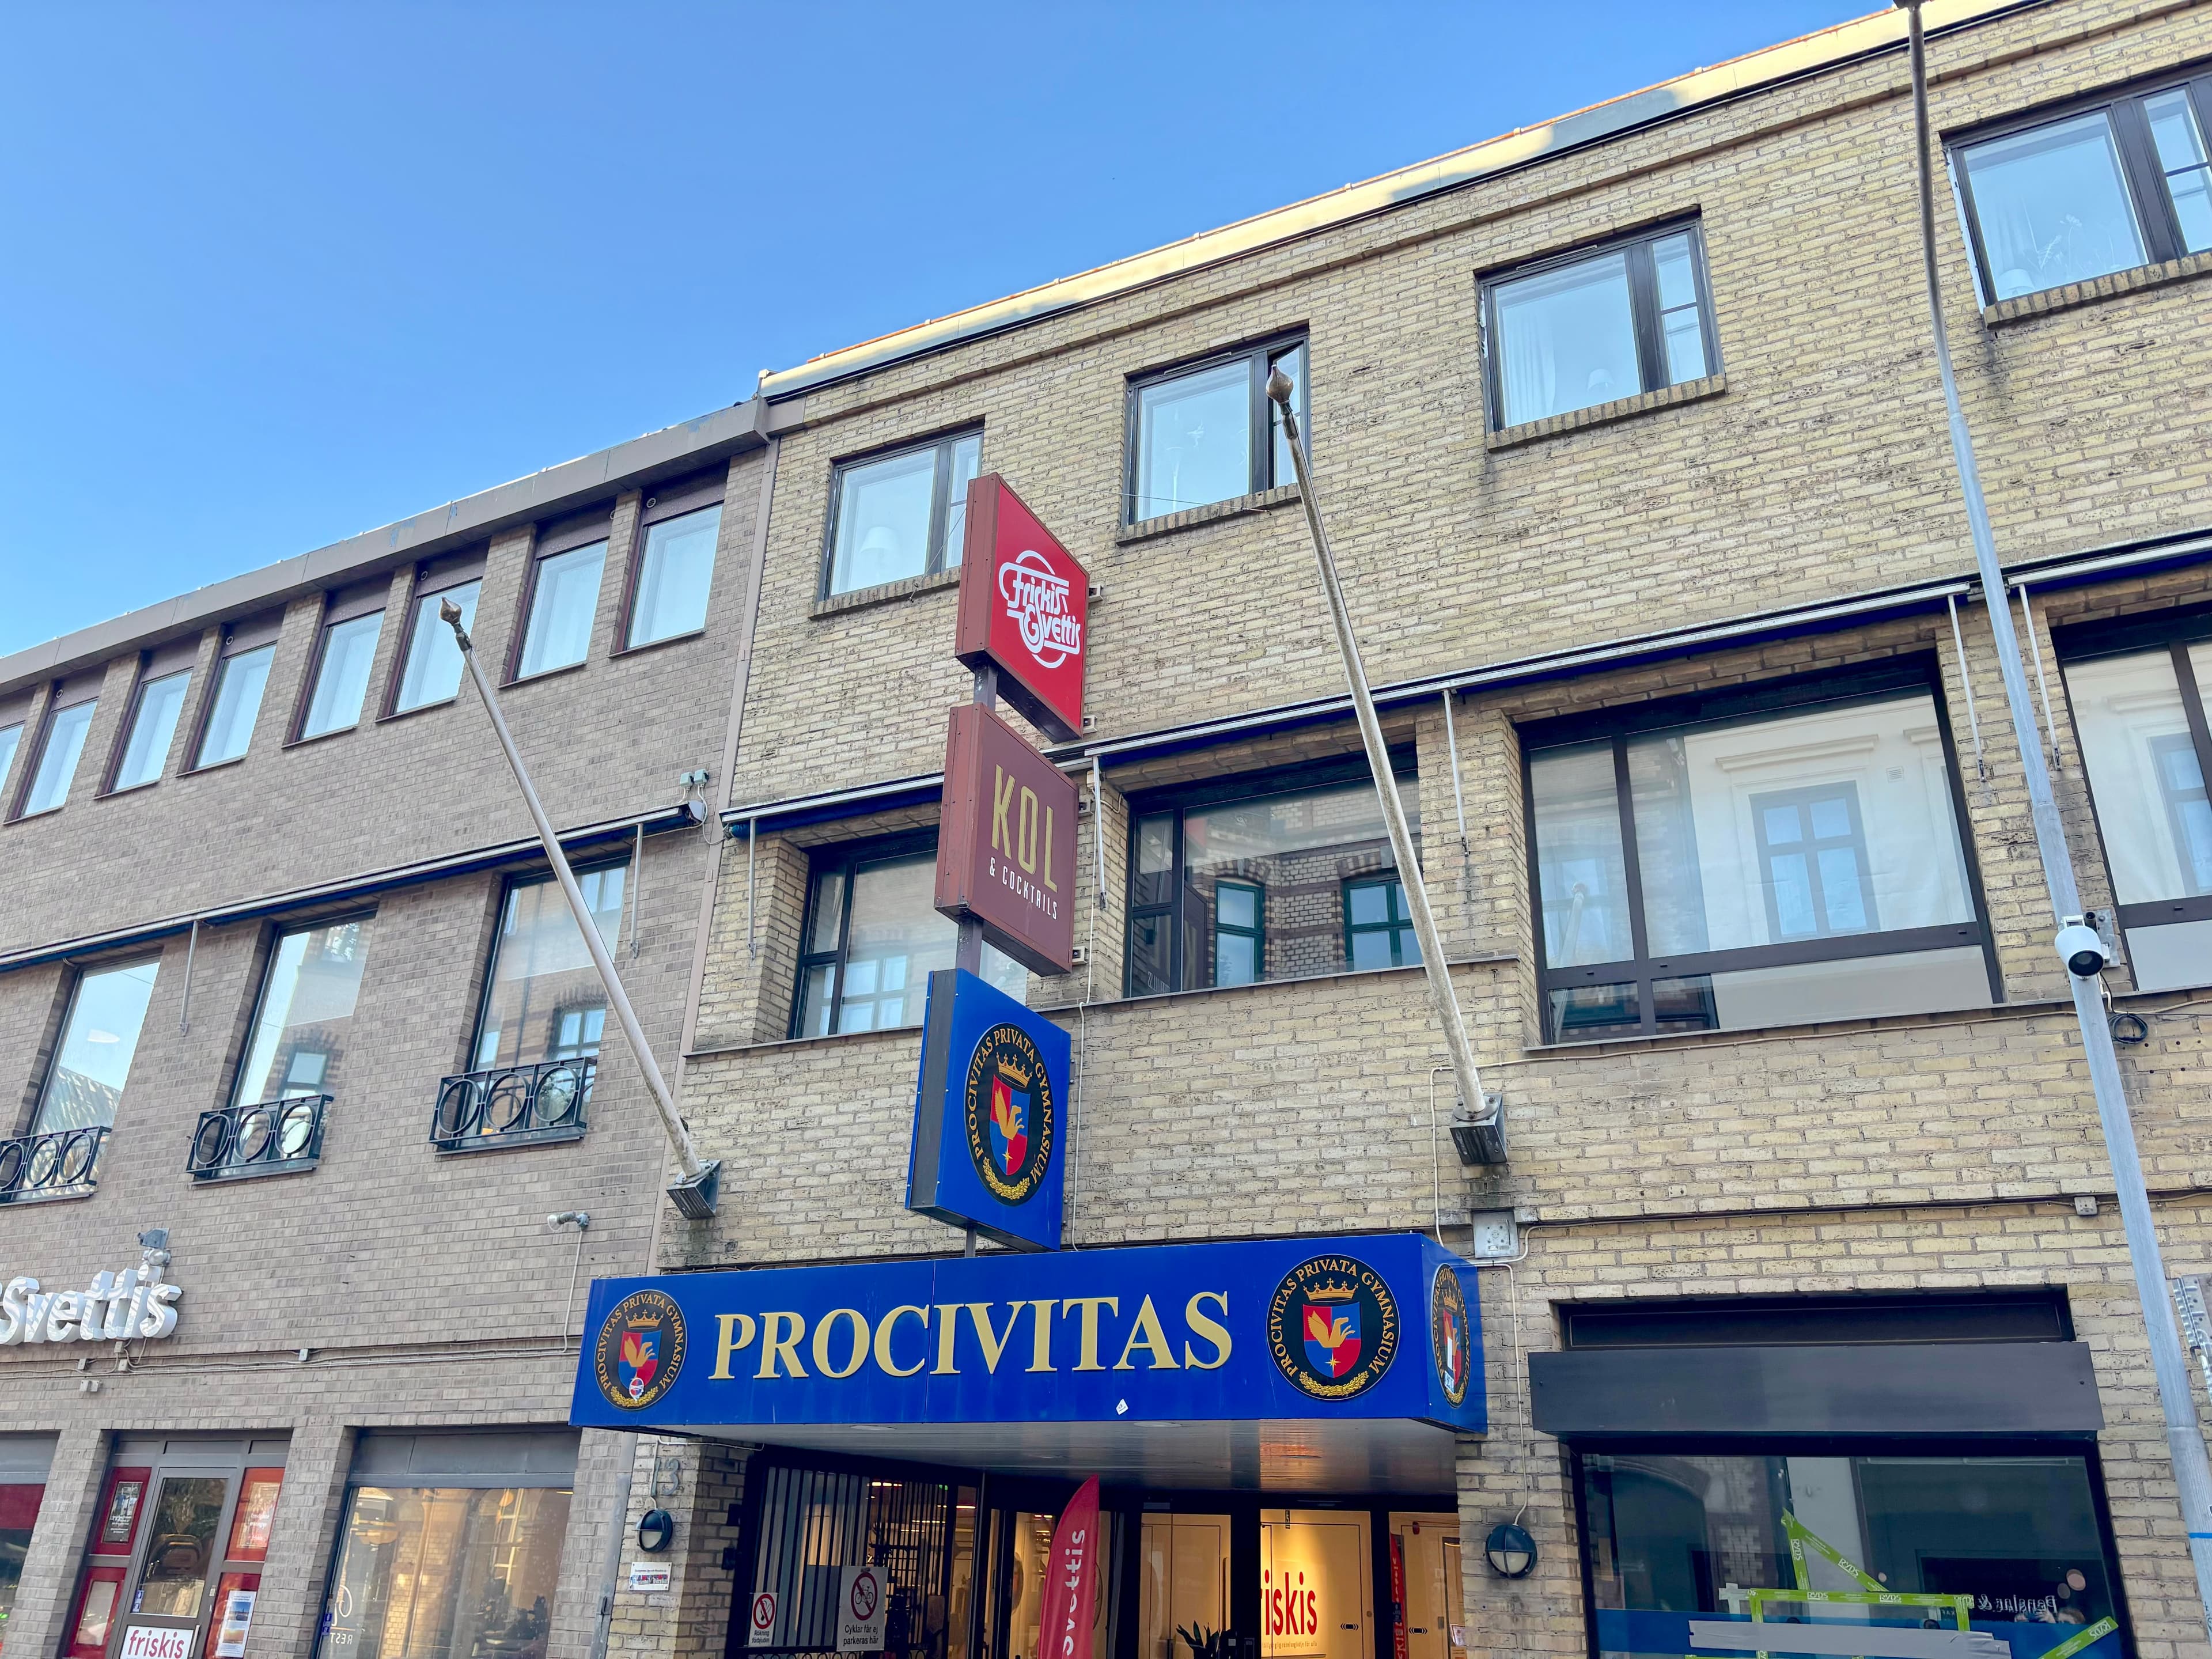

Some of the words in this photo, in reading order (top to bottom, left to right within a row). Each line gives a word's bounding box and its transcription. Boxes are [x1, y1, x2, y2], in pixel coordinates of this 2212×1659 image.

[991, 764, 1058, 893] KOL
[989, 857, 996, 877] &
[1002, 865, 1058, 920] COCKTAILS
[968, 1036, 994, 1160] PROCIVITAS
[994, 1028, 1035, 1064] PRIVATA
[1031, 1062, 1052, 1184] GYMNASIUM
[597, 1310, 623, 1391] PROCIVITAS
[622, 1293, 665, 1313] PRIVATA
[659, 1305, 684, 1389] GYMNASIUM
[707, 1290, 1233, 1380] PROCIVITAS
[1271, 1277, 1299, 1378] PROCIVITAS
[1296, 1259, 1358, 1282] PRIVATA
[1361, 1272, 1395, 1374] GYMNASIUM
[650, 1457, 679, 1496] 13
[1791, 1539, 1803, 1561] RYDS
[1838, 1558, 1859, 1577] RYDS
[1261, 1569, 1317, 1636] iskis
[128, 1630, 184, 1659] friskis
[843, 1637, 868, 1647] parkeras
[869, 1637, 879, 1645] här
[844, 1624, 862, 1635] Cyklar
[2088, 1620, 2112, 1639] RYDS
